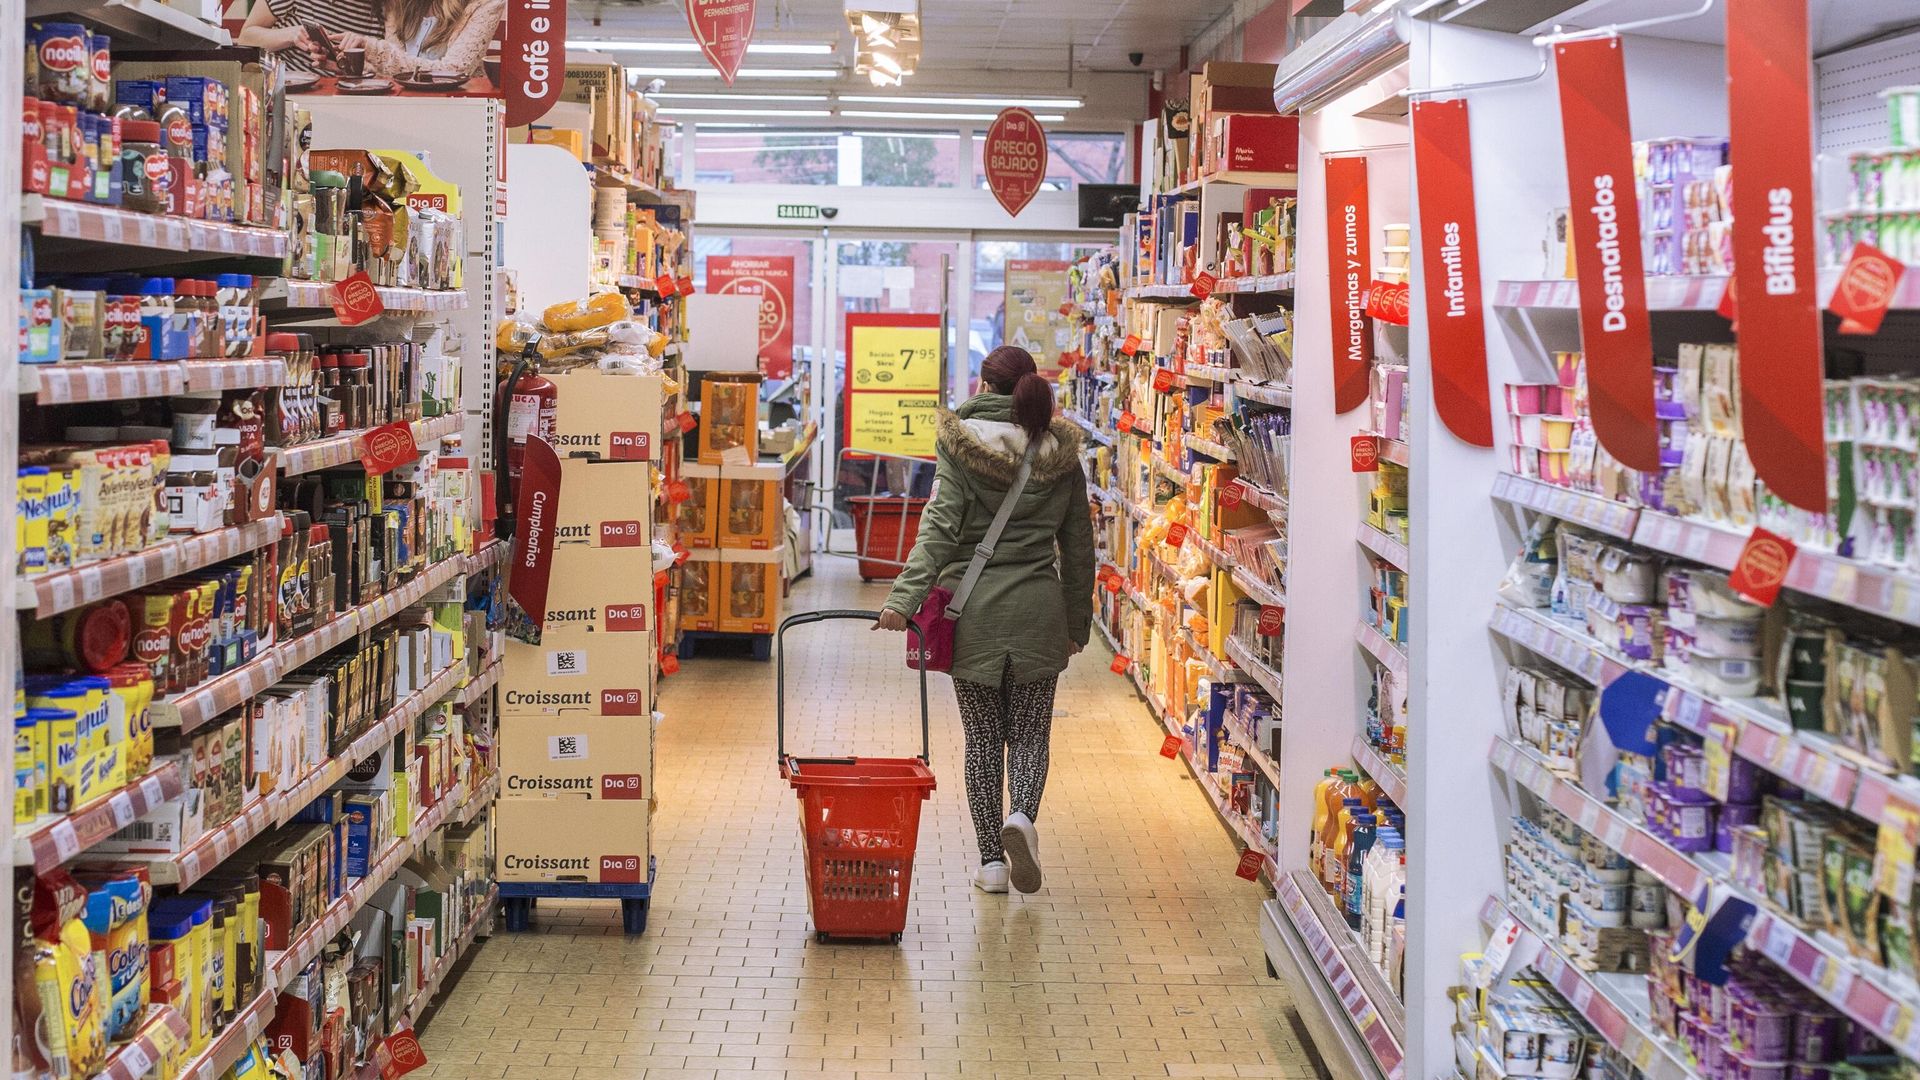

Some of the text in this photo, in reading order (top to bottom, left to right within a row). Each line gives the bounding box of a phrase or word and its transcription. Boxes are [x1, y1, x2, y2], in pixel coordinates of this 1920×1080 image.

[704, 3, 750, 17] PERMANENTEMENTE
[523, 0, 551, 98] Café e i
[565, 70, 607, 79] 008305505
[993, 139, 1037, 156] PRECIO
[990, 155, 1039, 172] BAJADO
[780, 206, 817, 218] SALIDA
[1590, 174, 1627, 332] Desnatados
[731, 260, 769, 269] AHORRAR
[1440, 222, 1466, 317] Infantiles
[1344, 204, 1362, 361] Margarinas y zumos
[613, 435, 633, 445] Dia
[525, 491, 547, 568] Cumpleaños
[603, 525, 623, 535] Dia
[608, 609, 628, 619] Dia
[506, 690, 592, 705] Croissant
[604, 693, 624, 703] Dia
[507, 775, 593, 790] Croissant
[605, 779, 624, 788] Dia
[504, 855, 590, 869] Croissant
[603, 859, 623, 869] Dia
